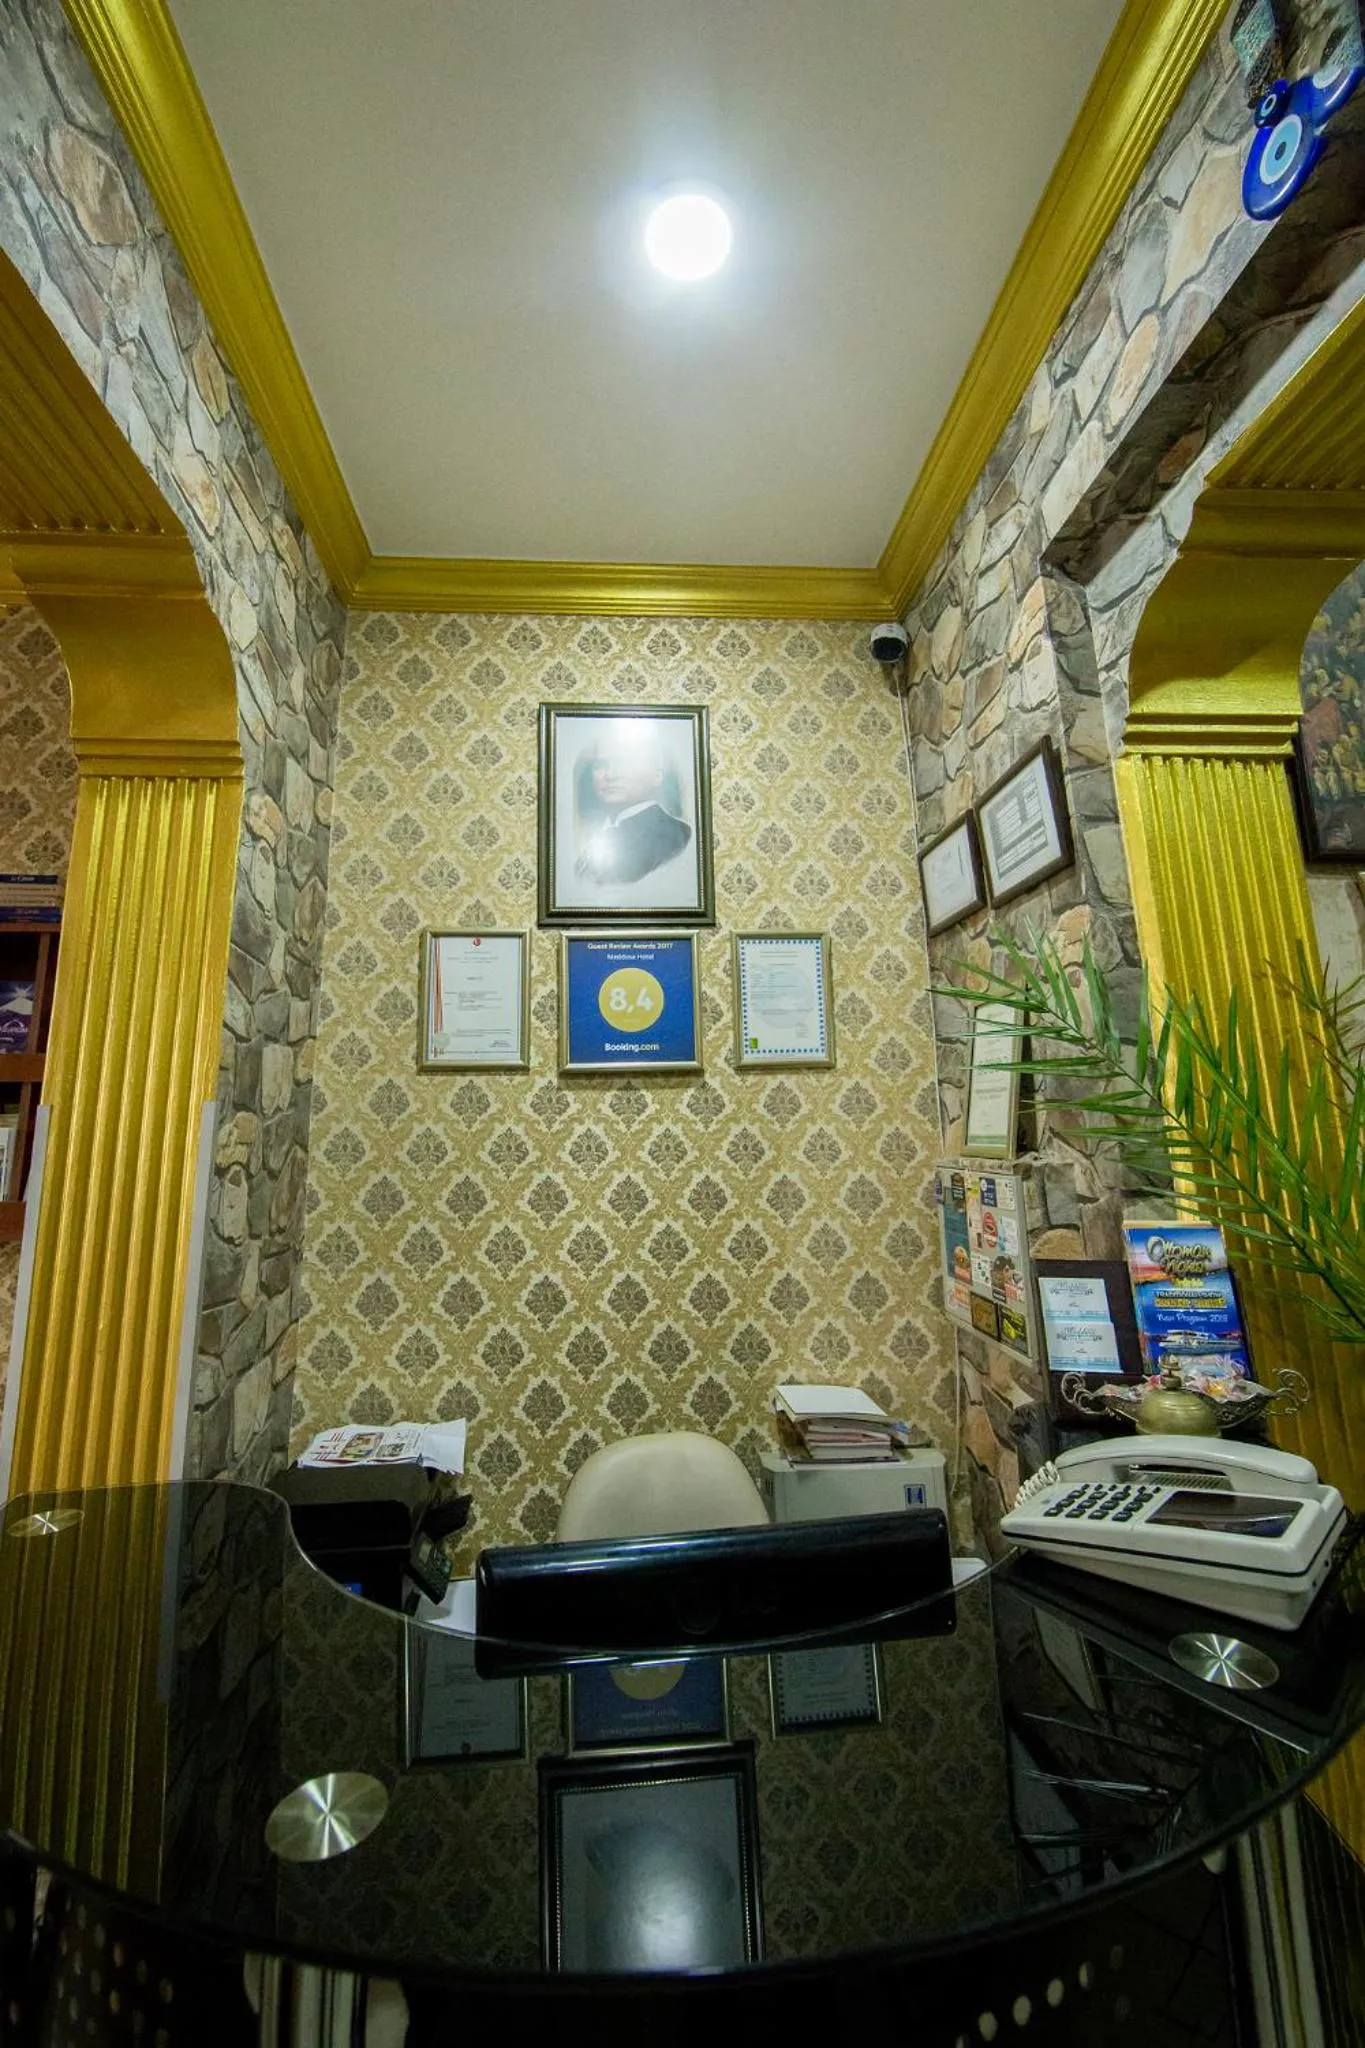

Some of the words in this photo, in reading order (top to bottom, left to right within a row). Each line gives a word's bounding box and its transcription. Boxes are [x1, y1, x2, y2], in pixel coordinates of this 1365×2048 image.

[608, 942, 632, 950] Review
[633, 942, 656, 950] Awards
[604, 1042, 660, 1053] Booking.com
